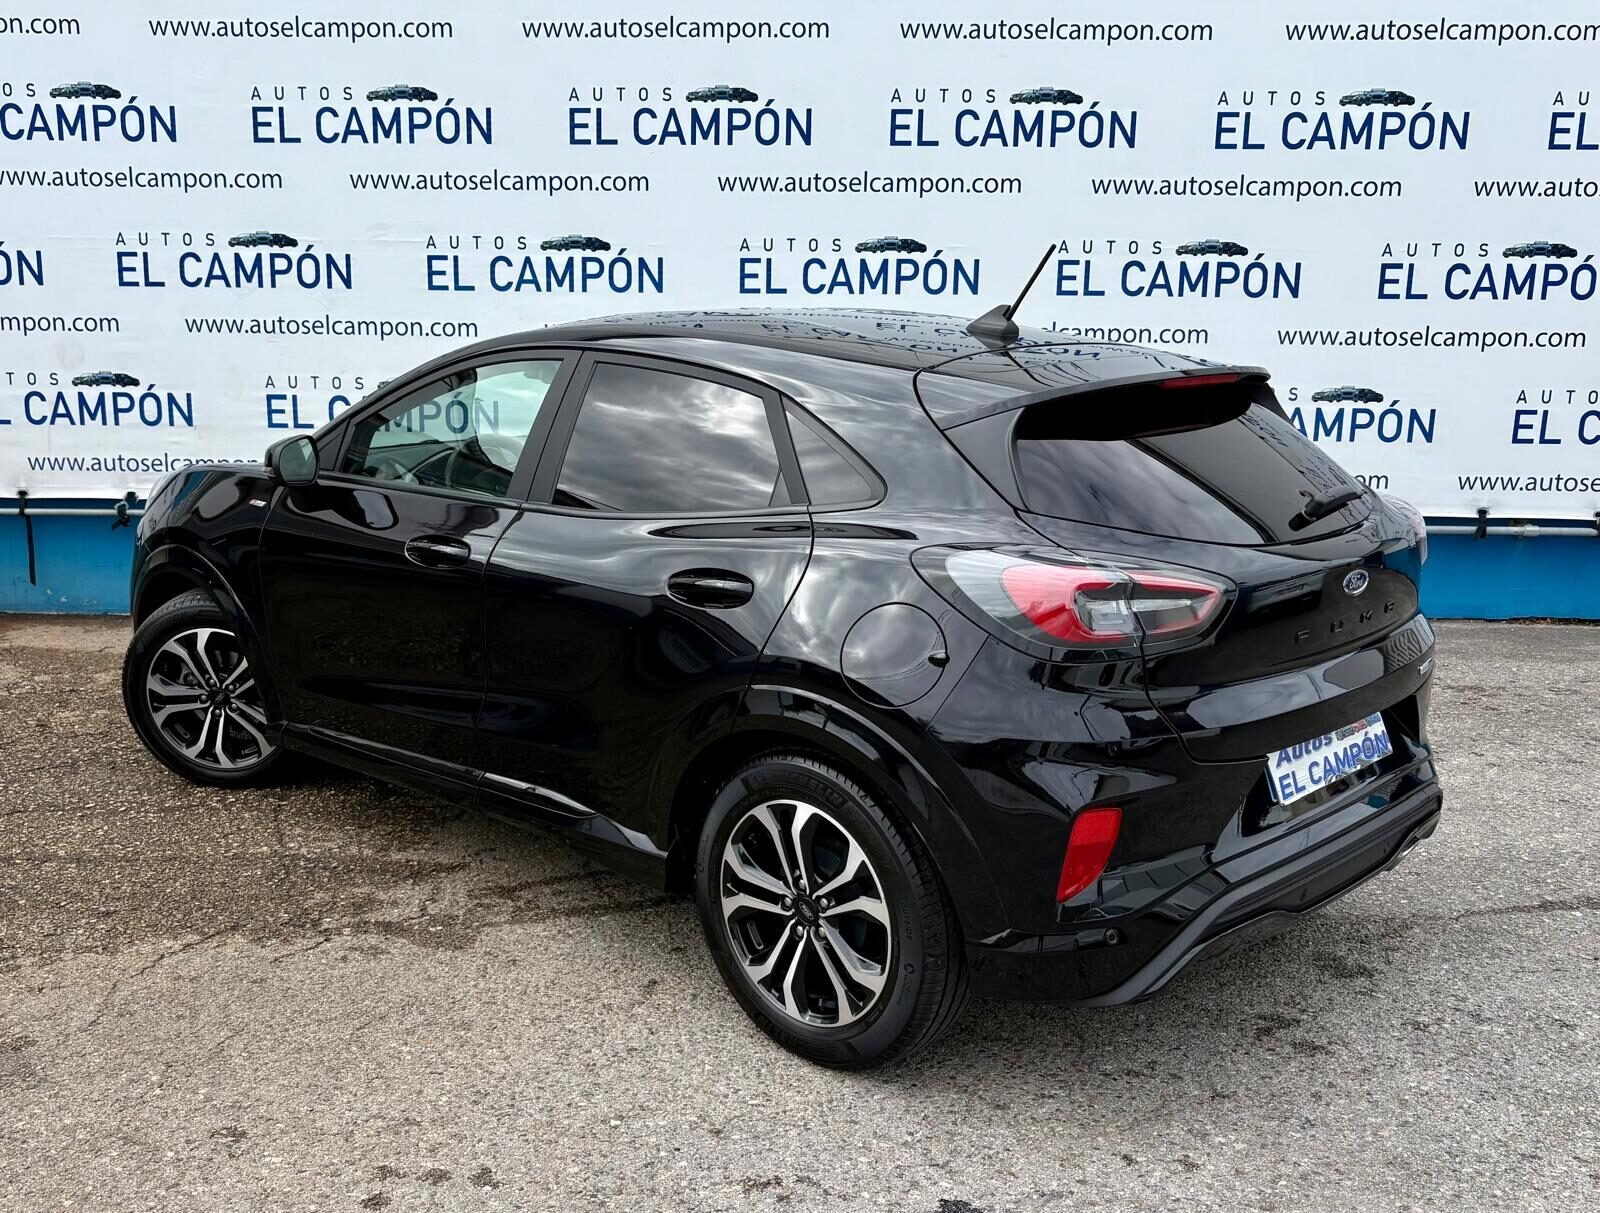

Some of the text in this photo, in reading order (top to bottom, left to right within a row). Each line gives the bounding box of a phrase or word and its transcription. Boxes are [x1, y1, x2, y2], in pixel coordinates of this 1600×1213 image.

[149, 15, 452, 43] www.autoselcampon.com
[522, 16, 829, 43] www.autoselcampon.com
[900, 17, 1212, 46] www.autoselcampon.com
[251, 86, 352, 100] AUTOS
[569, 87, 671, 101] AUTOS
[891, 88, 995, 103] AUTOS
[1218, 91, 1324, 105] AUTOS
[0, 95, 176, 142] CAMPÓN
[252, 99, 492, 144] EL CAMPÓN
[569, 100, 812, 145] EL CAMPÓN
[890, 101, 1137, 148] EL CAMPÓN
[1215, 104, 1470, 150] EL CAMPÓN
[1548, 112, 1599, 150] EL
[0, 166, 282, 193] ww.autoselcampon.com
[350, 169, 648, 196] www.autoselcampon.com
[718, 171, 1021, 198] www.autoselcampon.com
[1092, 174, 1401, 202] www.autoselcampon.com
[1475, 178, 1600, 197] www.auto
[116, 232, 214, 246] AUTOS
[426, 235, 526, 250] AUTOS
[740, 238, 841, 252] AUTOS
[1059, 240, 1161, 254] AUTOS
[1382, 243, 1488, 257] AUTOS
[117, 244, 352, 289] EL CAMPÓN
[427, 248, 663, 293] EL CAMPÓN
[740, 250, 979, 295] EL CAMPÓN
[1056, 252, 1301, 298] EL CAMPÓN
[1378, 255, 1597, 300] EL CAMPÓ
[1, 316, 119, 336] mpon.com
[185, 315, 477, 339] www.autoselcampon.com
[1278, 326, 1585, 352] www.autoselcampon.com
[6, 372, 58, 385] TOS
[266, 376, 363, 390] AUTOS
[24, 383, 193, 427] CAMPÓN
[266, 394, 314, 429] EL
[1512, 410, 1561, 444] EL
[1275, 734, 1333, 769] Autos
[1278, 730, 1389, 801] EL CAMPÓN
